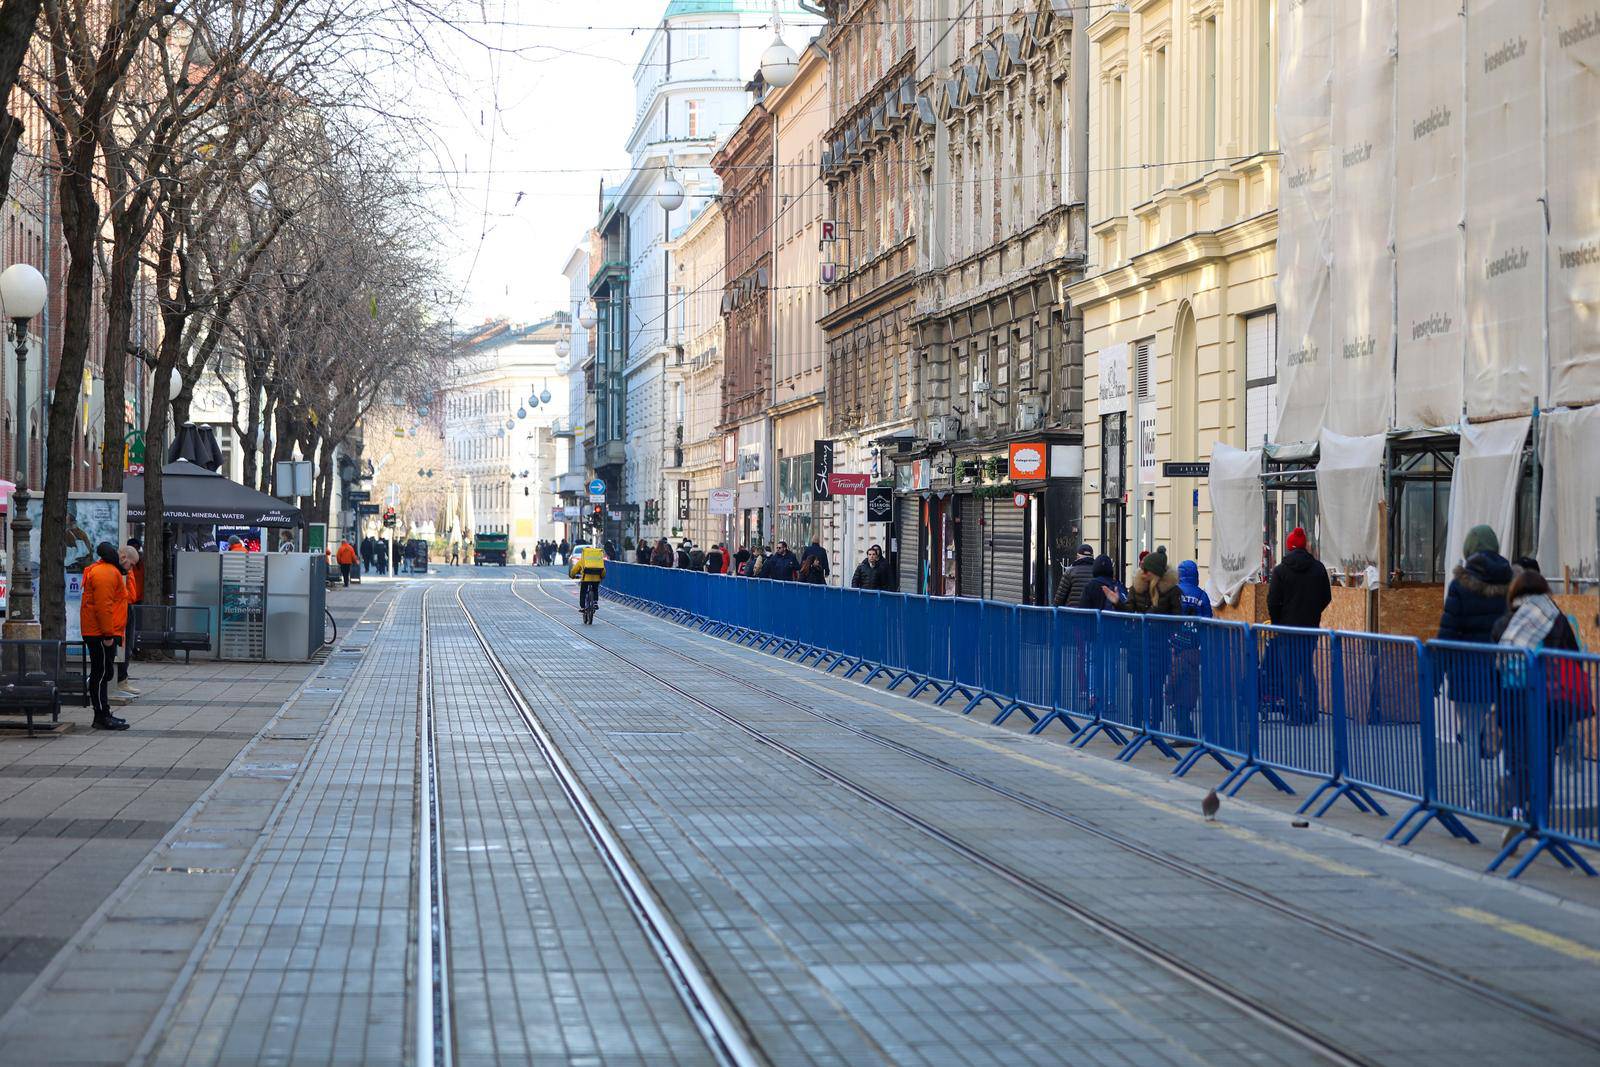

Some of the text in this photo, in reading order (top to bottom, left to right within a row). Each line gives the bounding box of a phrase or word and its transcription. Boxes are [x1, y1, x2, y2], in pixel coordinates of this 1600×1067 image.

[815, 444, 832, 498] Skiny
[832, 478, 865, 492] Triumph
[256, 514, 291, 523] Jamnica
